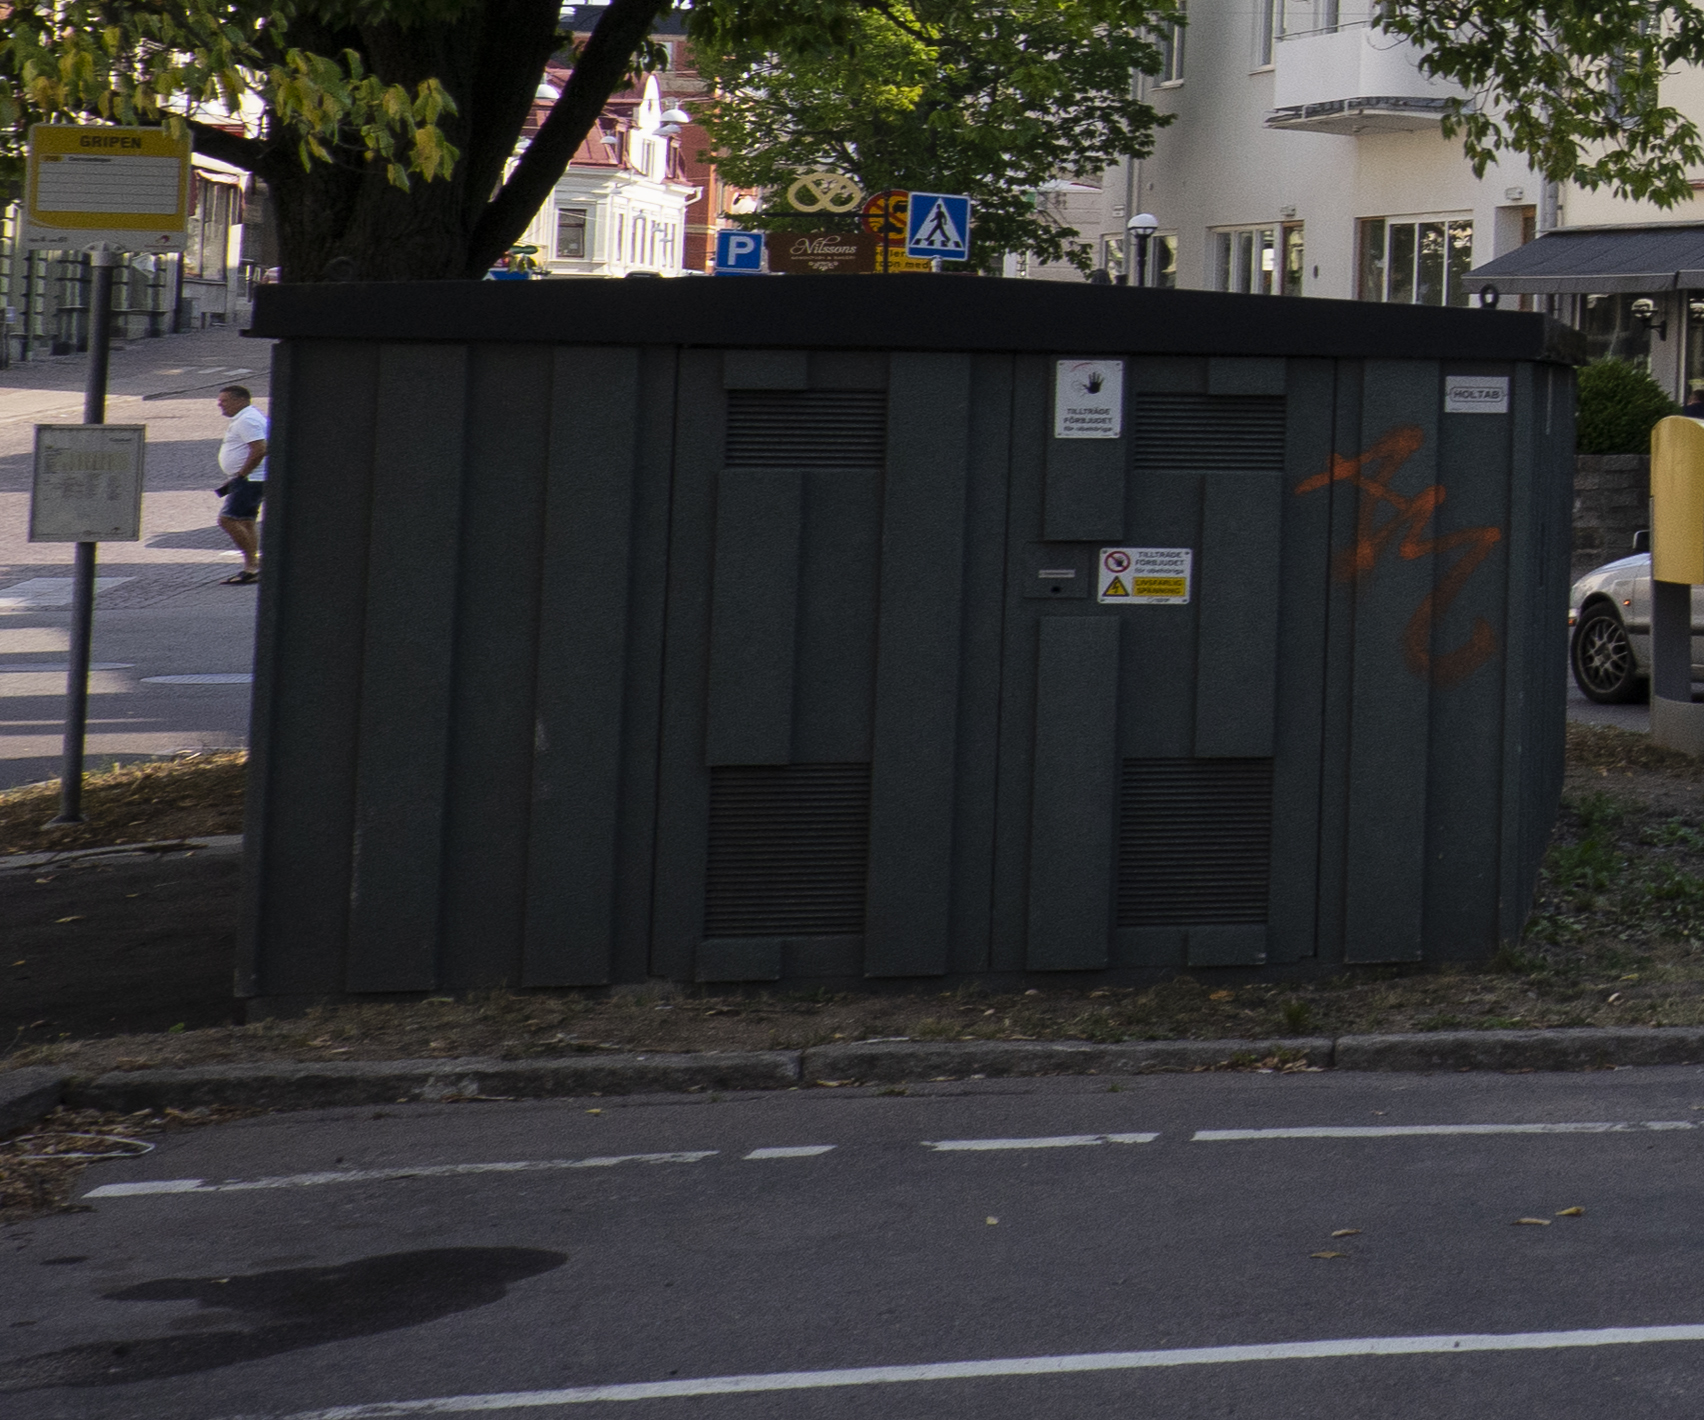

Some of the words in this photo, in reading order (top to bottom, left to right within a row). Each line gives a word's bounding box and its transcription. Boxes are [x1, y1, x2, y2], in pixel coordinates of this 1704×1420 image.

[79, 135, 142, 149] GRIPEN
[789, 235, 857, 256] Nilssons
[1453, 389, 1500, 399] HOLTAB
[1067, 407, 1110, 415] TILLTRÄDE
[1063, 416, 1113, 424] FÖRBJUDET
[1138, 551, 1182, 559] TILLTRÄDE
